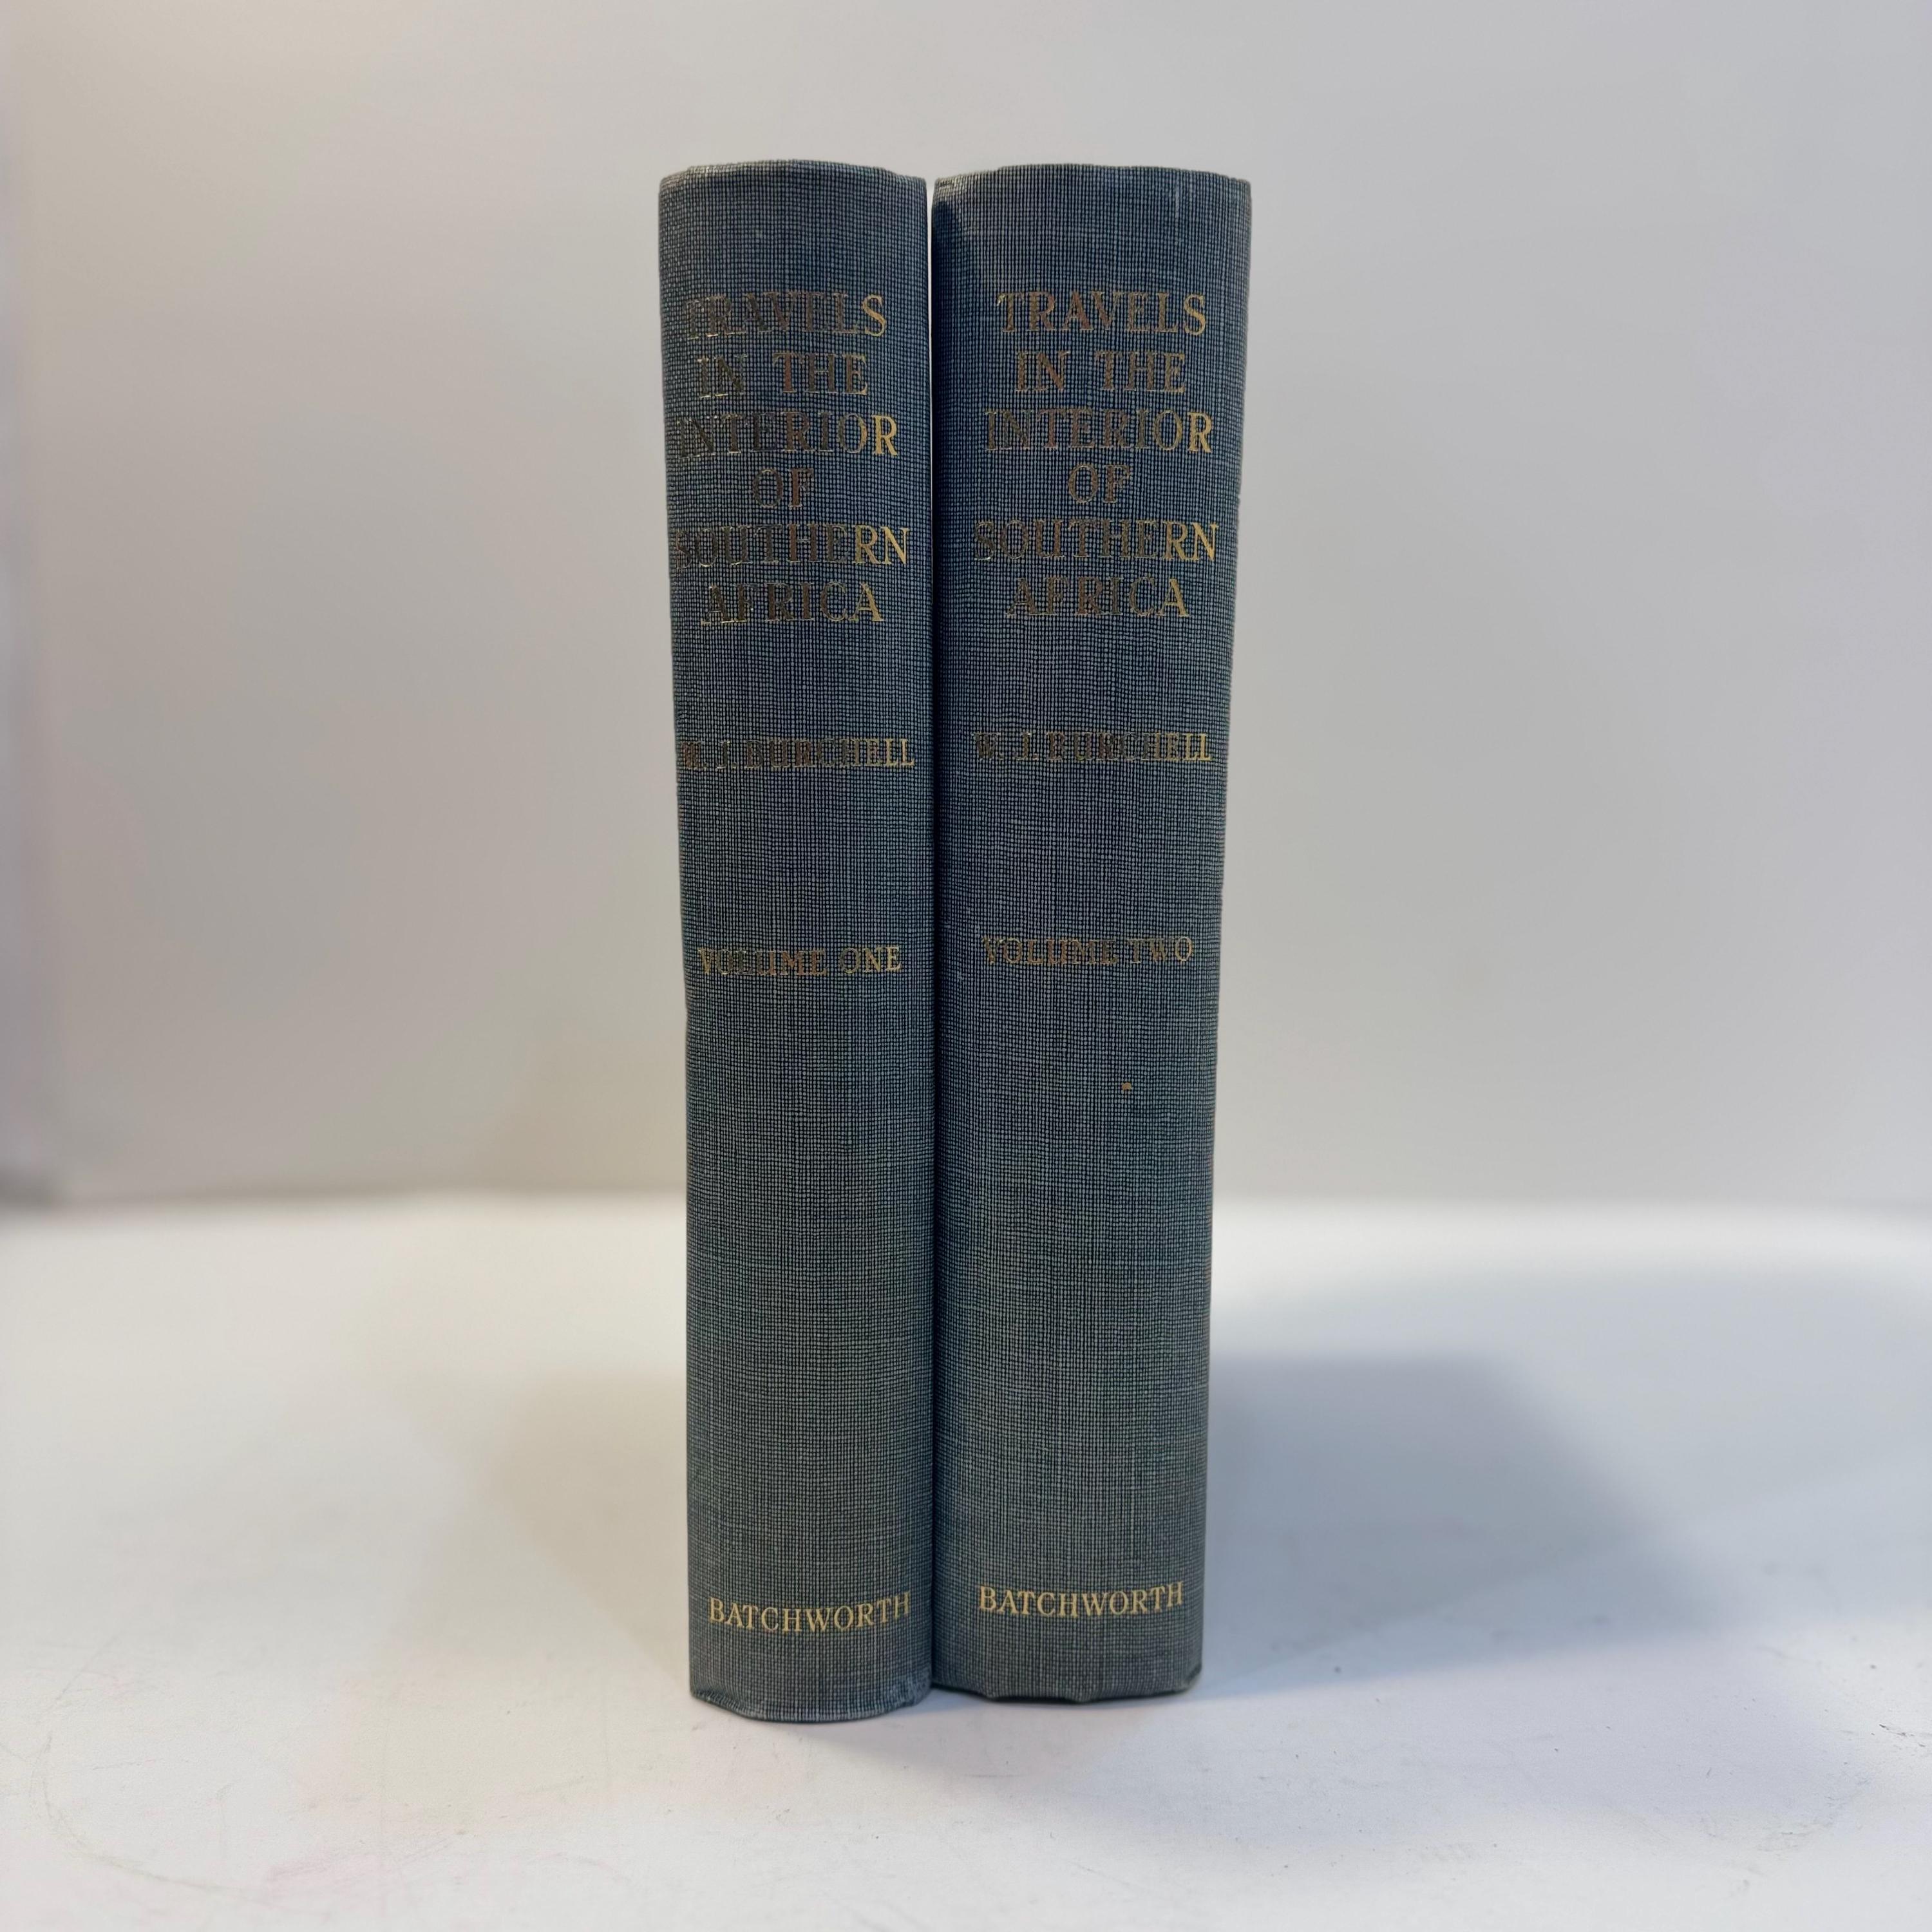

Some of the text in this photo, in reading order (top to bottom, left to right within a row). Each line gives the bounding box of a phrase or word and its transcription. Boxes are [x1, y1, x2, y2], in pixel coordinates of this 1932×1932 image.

[685, 292, 887, 340] TRAVELS
[998, 291, 1206, 336] TRAVELS
[697, 351, 868, 398] IN THE
[1016, 350, 1186, 393] IN THE
[984, 406, 1213, 453] INTERIOR
[752, 468, 814, 508] OF
[1068, 464, 1132, 504] OF
[675, 524, 910, 569] SOUTHERN
[974, 519, 1219, 562] SOUTHERN
[700, 582, 885, 625] AFRICA
[1005, 577, 1190, 618] AFRICA
[744, 738, 916, 769] BURCHELL
[1046, 731, 1213, 762] BURCHELL
[698, 944, 902, 976] VOLUME ONE
[981, 936, 1195, 965] VOLUME TWO
[708, 1593, 911, 1634] BATCHWORTH
[978, 1580, 1184, 1618] BATCHWORTH
